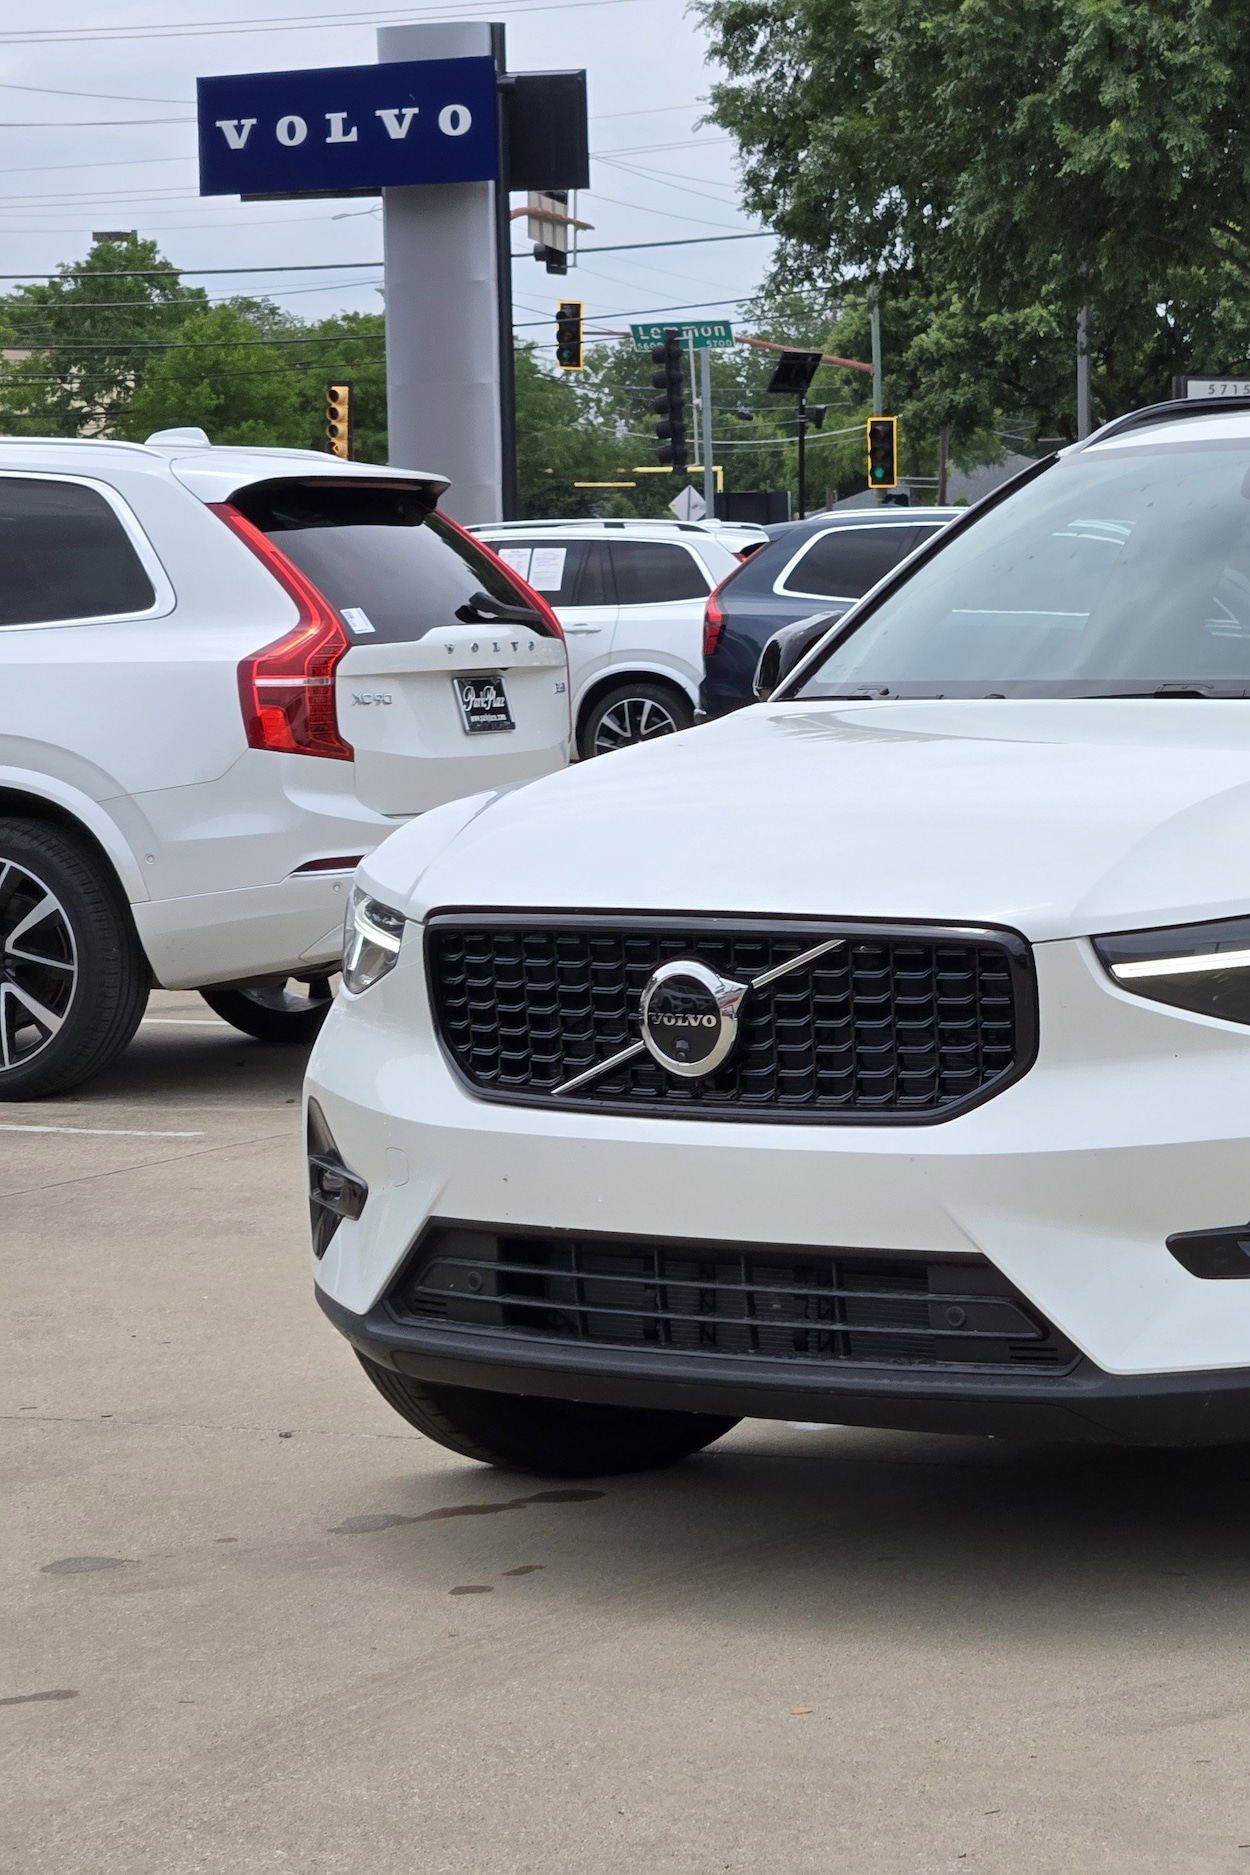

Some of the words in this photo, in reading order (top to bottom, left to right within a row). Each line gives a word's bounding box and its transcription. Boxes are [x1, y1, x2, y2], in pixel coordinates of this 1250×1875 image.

[215, 104, 472, 149] VOLVO
[638, 325, 725, 340] Lemon
[706, 339, 732, 348] 5700
[1208, 384, 1250, 395] 5715
[444, 640, 535, 655] VOLVO
[352, 693, 393, 706] XC90
[648, 1012, 717, 1028] VOLVO
